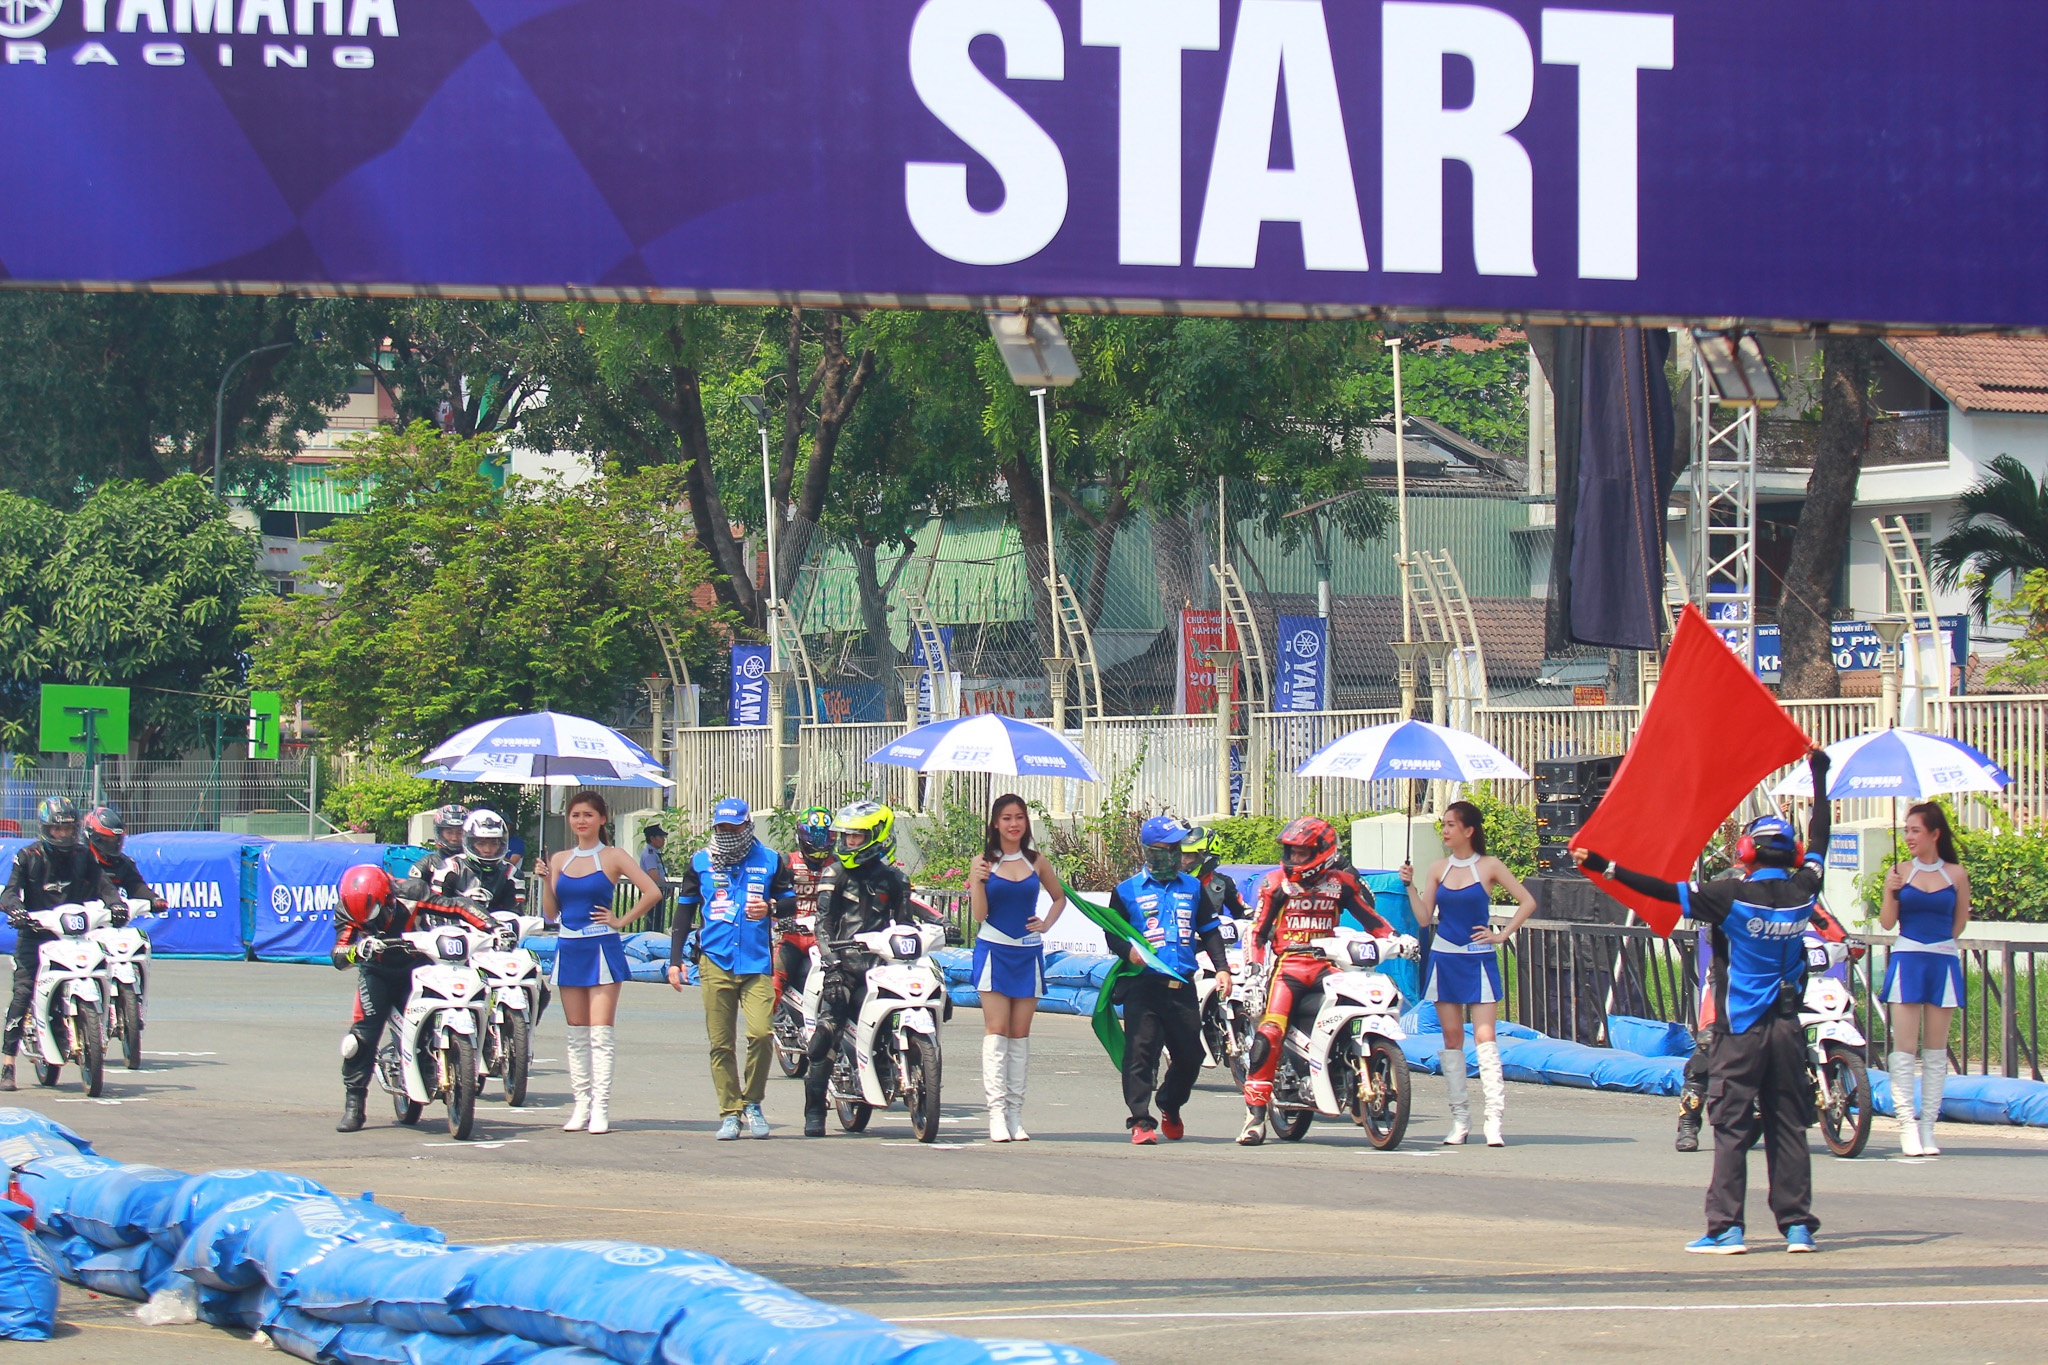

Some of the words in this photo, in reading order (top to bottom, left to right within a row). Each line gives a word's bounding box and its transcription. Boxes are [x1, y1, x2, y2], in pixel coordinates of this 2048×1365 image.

[5, 42, 375, 69] RACING
[905, 0, 1674, 280] START
[1033, 755, 1067, 766] YAMAHA
[1401, 760, 1442, 769] YAMAHA
[1861, 775, 1903, 786] YAMAHA
[149, 882, 222, 909] AMAHA
[291, 885, 340, 912] YAMA
[1286, 900, 1335, 911] MOTUL
[71, 914, 85, 930] 39
[144, 911, 217, 919] ACING
[280, 914, 336, 922] RACI
[1286, 916, 1333, 930] YAMAHA
[1221, 926, 1236, 940] 32
[447, 940, 463, 955] 30
[901, 938, 916, 954] 37
[1359, 944, 1376, 959] 24
[1810, 949, 1826, 966] 29
[1322, 1015, 1343, 1027] ENEOS
